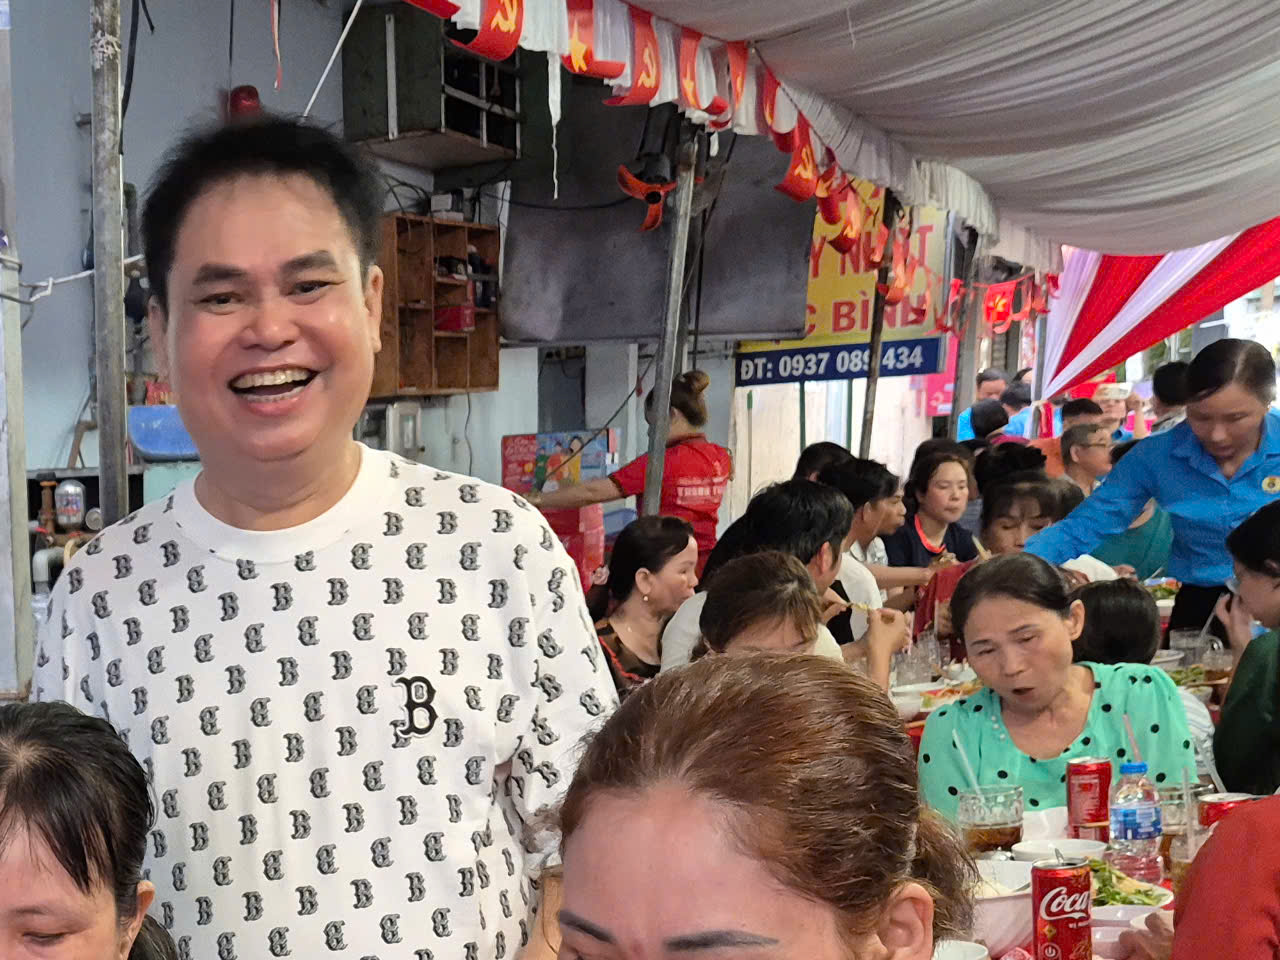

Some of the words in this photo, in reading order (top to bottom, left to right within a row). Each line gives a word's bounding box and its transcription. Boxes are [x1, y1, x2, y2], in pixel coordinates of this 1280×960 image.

[740, 357, 773, 381] ĐT:
[778, 352, 830, 378] 0937
[882, 345, 924, 371] 434
[383, 512, 404, 536] B
[436, 511, 458, 534] B
[492, 509, 513, 533] B
[112, 554, 132, 579] B
[160, 540, 181, 567] B
[270, 582, 293, 611] B
[326, 578, 349, 606] B
[382, 578, 404, 605] B
[436, 578, 457, 604] B
[488, 579, 509, 609] B
[169, 605, 190, 633] B
[218, 592, 239, 622] B
[123, 617, 142, 646] B
[277, 657, 299, 686] B
[330, 650, 352, 680] B
[386, 648, 407, 675] B
[439, 648, 460, 676] B
[175, 674, 195, 703] B
[225, 664, 246, 695] B
[131, 687, 148, 716] B
[394, 675, 439, 736] B
[335, 726, 358, 756] B
[443, 718, 464, 747] B
[181, 747, 202, 777] B
[232, 739, 252, 769] B
[283, 733, 305, 762] B
[289, 810, 311, 839] B
[342, 803, 365, 833] B
[396, 795, 418, 825] B
[189, 822, 209, 851] B
[238, 814, 258, 845] B
[350, 879, 374, 909] B
[405, 872, 426, 902] B
[457, 867, 474, 897] B
[195, 896, 213, 925] B
[242, 891, 264, 922] B
[295, 885, 319, 916] B
